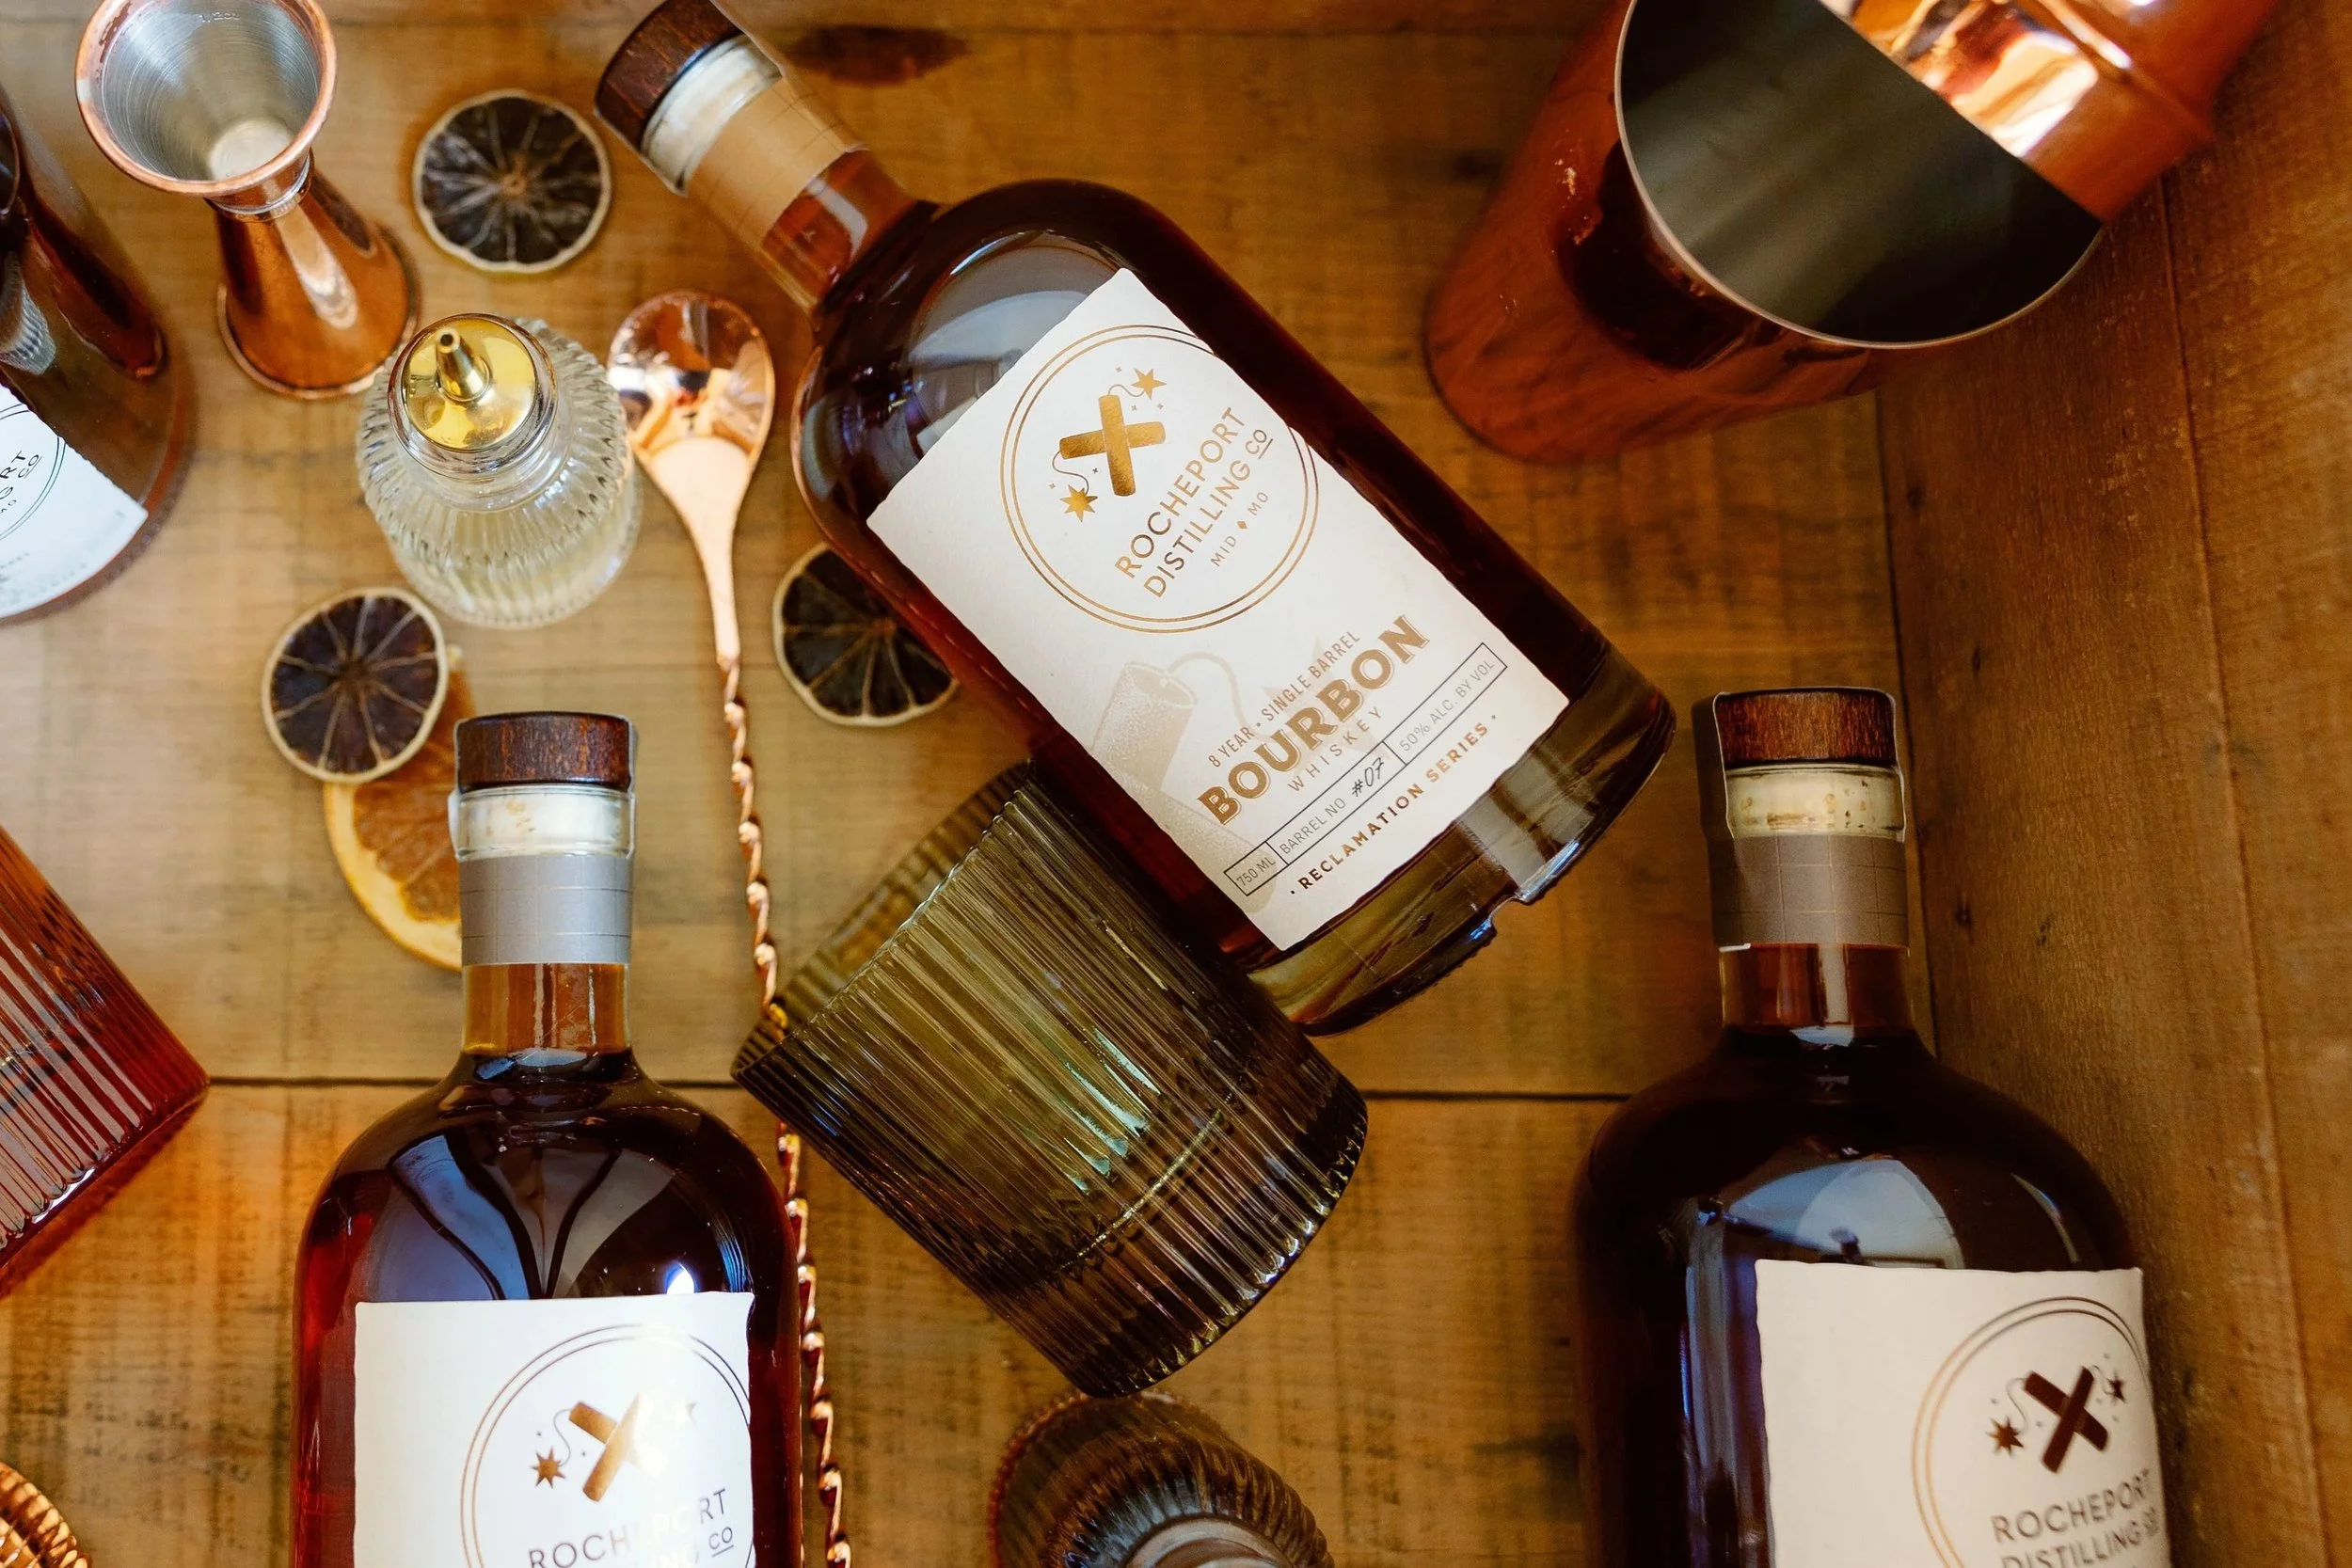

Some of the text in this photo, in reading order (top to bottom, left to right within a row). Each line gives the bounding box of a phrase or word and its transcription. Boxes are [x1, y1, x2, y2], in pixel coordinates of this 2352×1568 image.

[1115, 407, 1245, 578] ROCHEPORT
[1143, 429, 1271, 597] DISTILLING CO
[1211, 491, 1268, 566] MID MO
[1197, 615, 1430, 825] BOURBON
[1207, 631, 1360, 768] 8 YEAR SINGLE BARREL
[1399, 660, 1495, 752] 50% ALC. BY VOL
[1287, 706, 1383, 792] WHISKEY
[1279, 757, 1385, 855] BARREL NO #07
[1297, 722, 1488, 890] RECLAMATION SERIES
[1235, 857, 1277, 887] 750 ML
[529, 1487, 726, 1568] ROCHRT
[708, 1526, 734, 1558] CO
